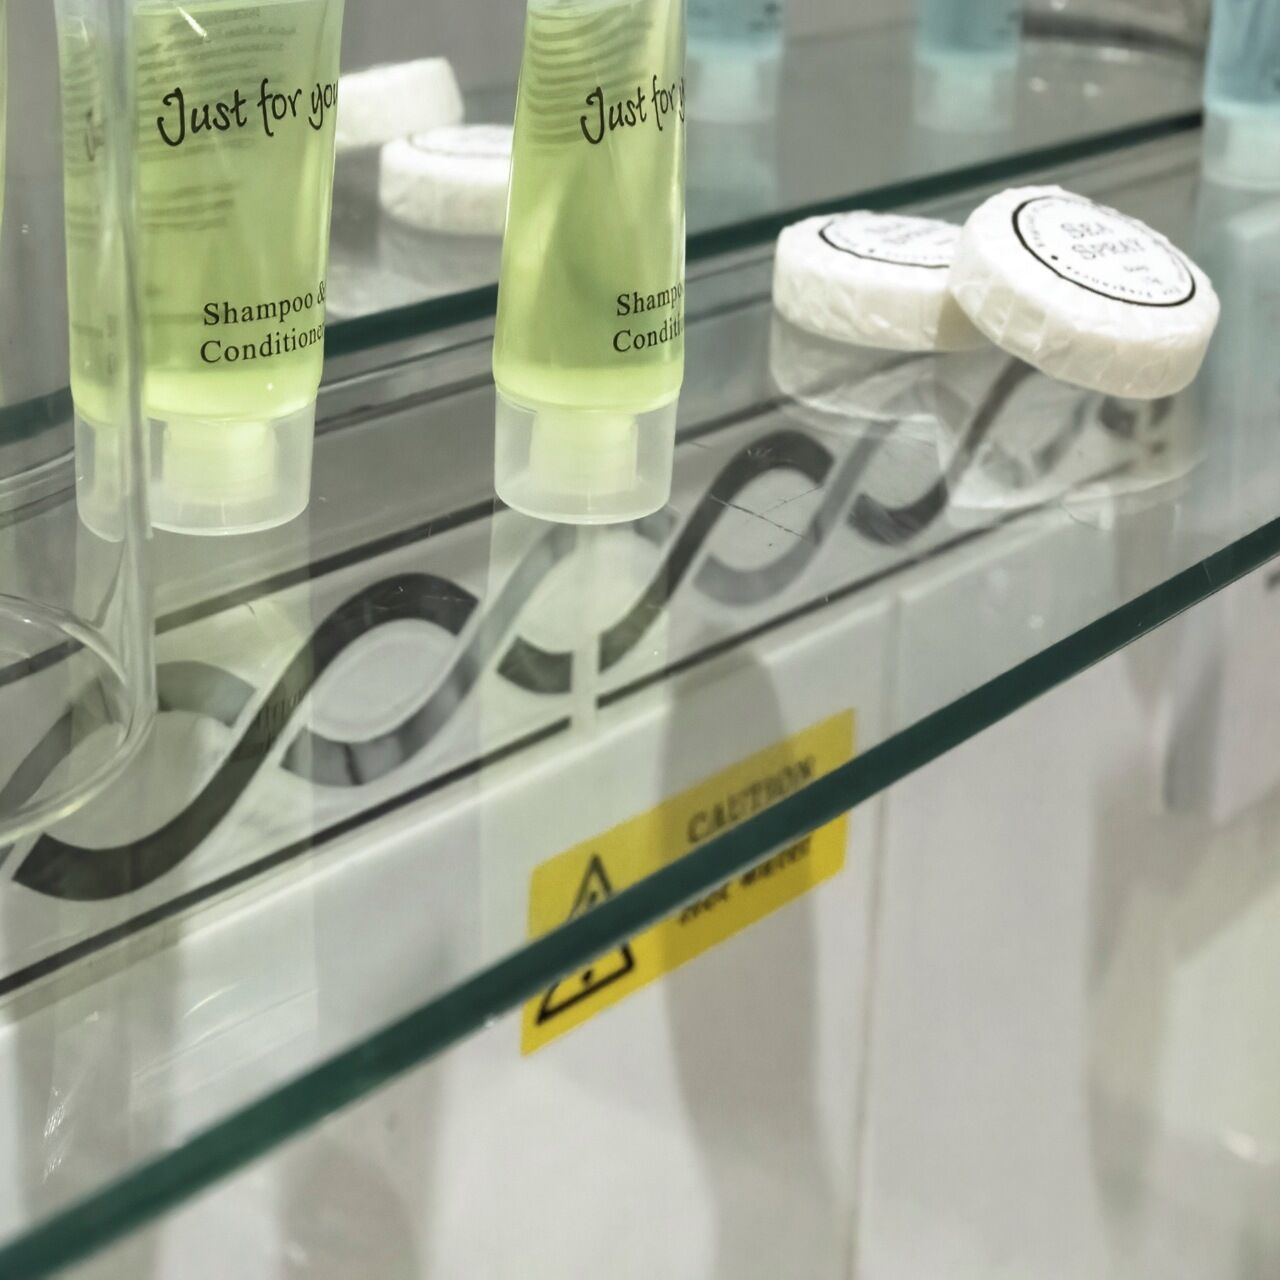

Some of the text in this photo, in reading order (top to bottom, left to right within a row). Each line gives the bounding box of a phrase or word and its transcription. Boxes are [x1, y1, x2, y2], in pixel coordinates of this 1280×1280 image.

[156, 87, 247, 147] Just
[257, 78, 302, 137] for
[308, 80, 338, 130] you
[580, 86, 647, 145] Just
[651, 74, 675, 131] for
[203, 292, 313, 325] Shampoo
[616, 282, 683, 316] Shampo
[613, 312, 683, 352] Conditi
